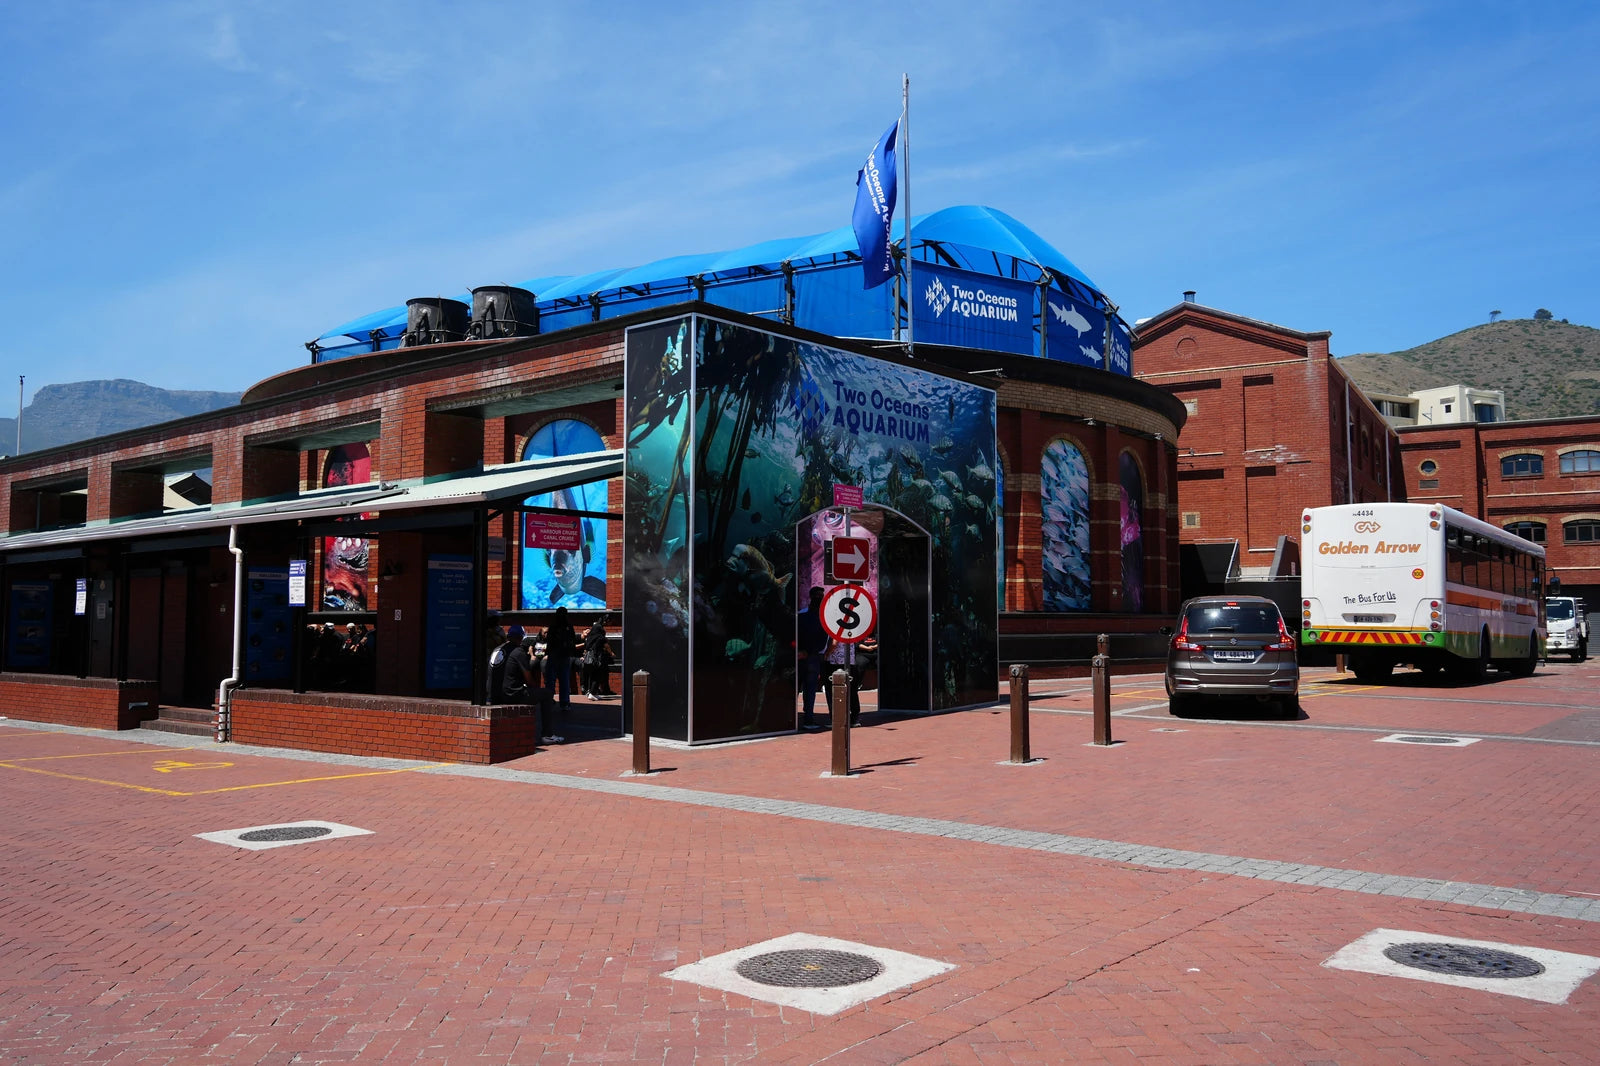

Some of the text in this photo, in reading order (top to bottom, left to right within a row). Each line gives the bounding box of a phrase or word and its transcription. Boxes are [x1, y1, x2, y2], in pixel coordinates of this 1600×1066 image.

[870, 169, 886, 203] Oceans
[951, 284, 1018, 308] Two Oceans
[951, 299, 1018, 323] AQUARIUM
[832, 379, 930, 420] Two Oceans
[832, 405, 930, 444] AQUARIUM
[1318, 540, 1422, 555] Golden Arrow
[1343, 591, 1397, 604] The Bus For Us
[836, 597, 861, 629] S
